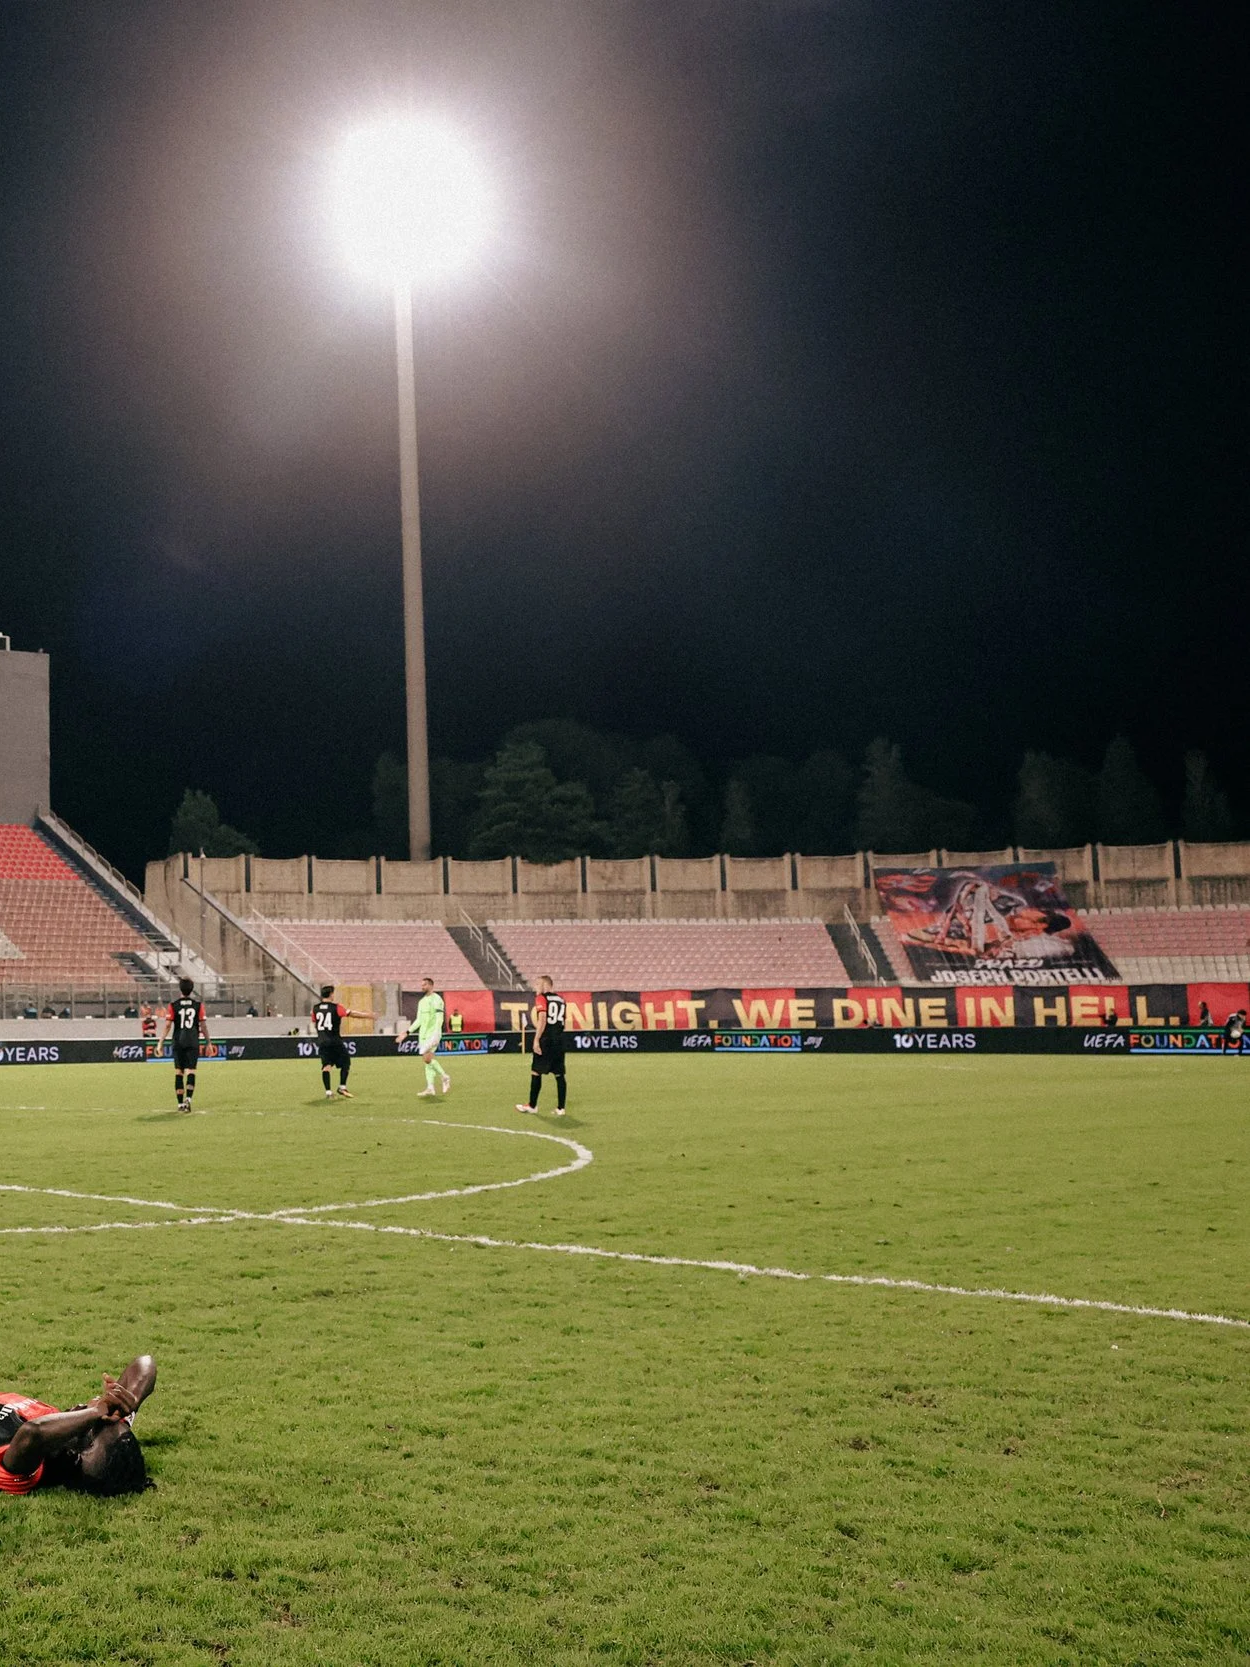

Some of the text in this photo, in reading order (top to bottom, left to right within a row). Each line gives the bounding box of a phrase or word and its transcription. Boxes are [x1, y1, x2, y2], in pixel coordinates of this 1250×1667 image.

[930, 967, 1107, 984] JOSEPH PORTELLI
[178, 1007, 196, 1029] 13
[315, 1011, 333, 1031] 24
[547, 1001, 565, 1026] 94
[732, 998, 817, 1029] WE
[832, 996, 949, 1029] DINE
[964, 995, 1016, 1028] IN
[682, 1034, 712, 1048] UEFA
[1083, 1033, 1125, 1049] UEFA
